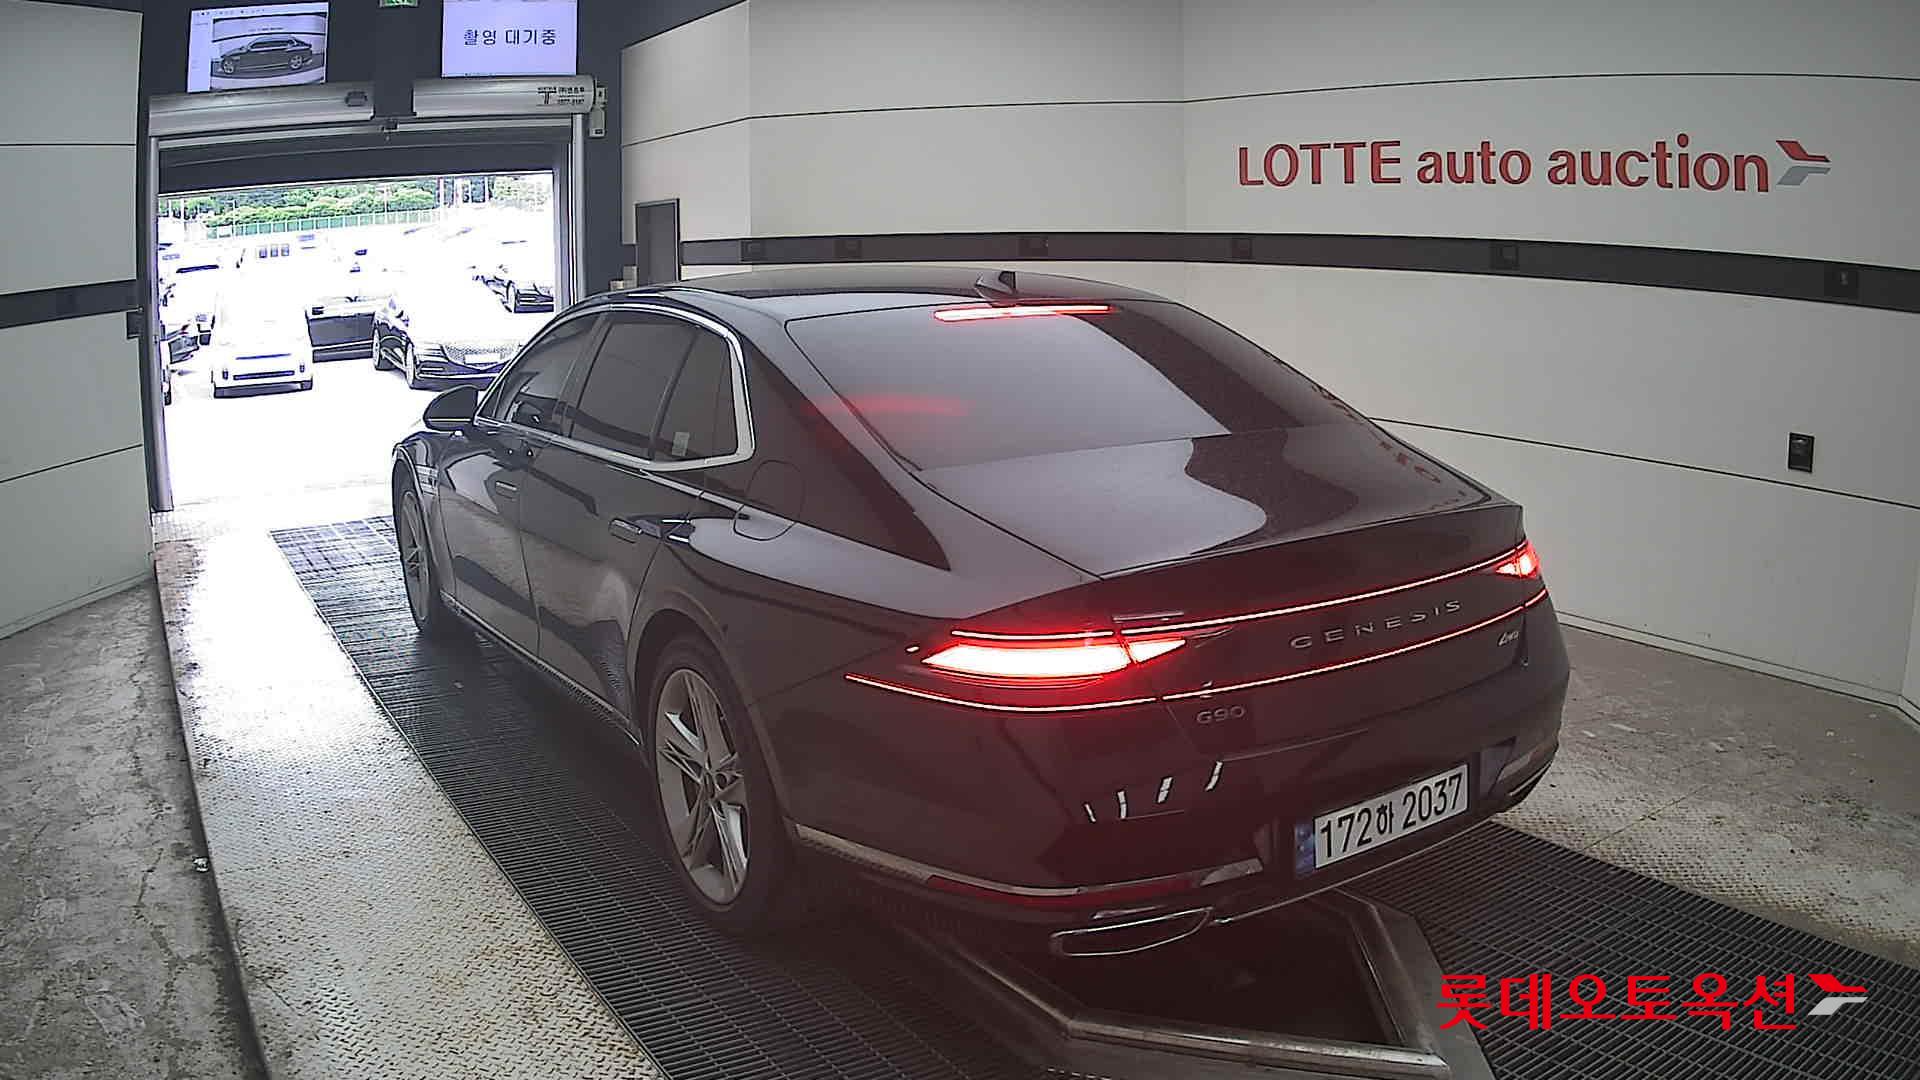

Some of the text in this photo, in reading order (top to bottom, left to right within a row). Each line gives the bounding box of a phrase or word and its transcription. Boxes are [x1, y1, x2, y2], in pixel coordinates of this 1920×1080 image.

[464, 29, 556, 46] 촬영 대기중
[1238, 132, 1769, 193] LOTTE auto auction
[1289, 600, 1462, 649] GENESIS
[1196, 705, 1245, 724] G90
[1320, 772, 1463, 858] 172하 2037
